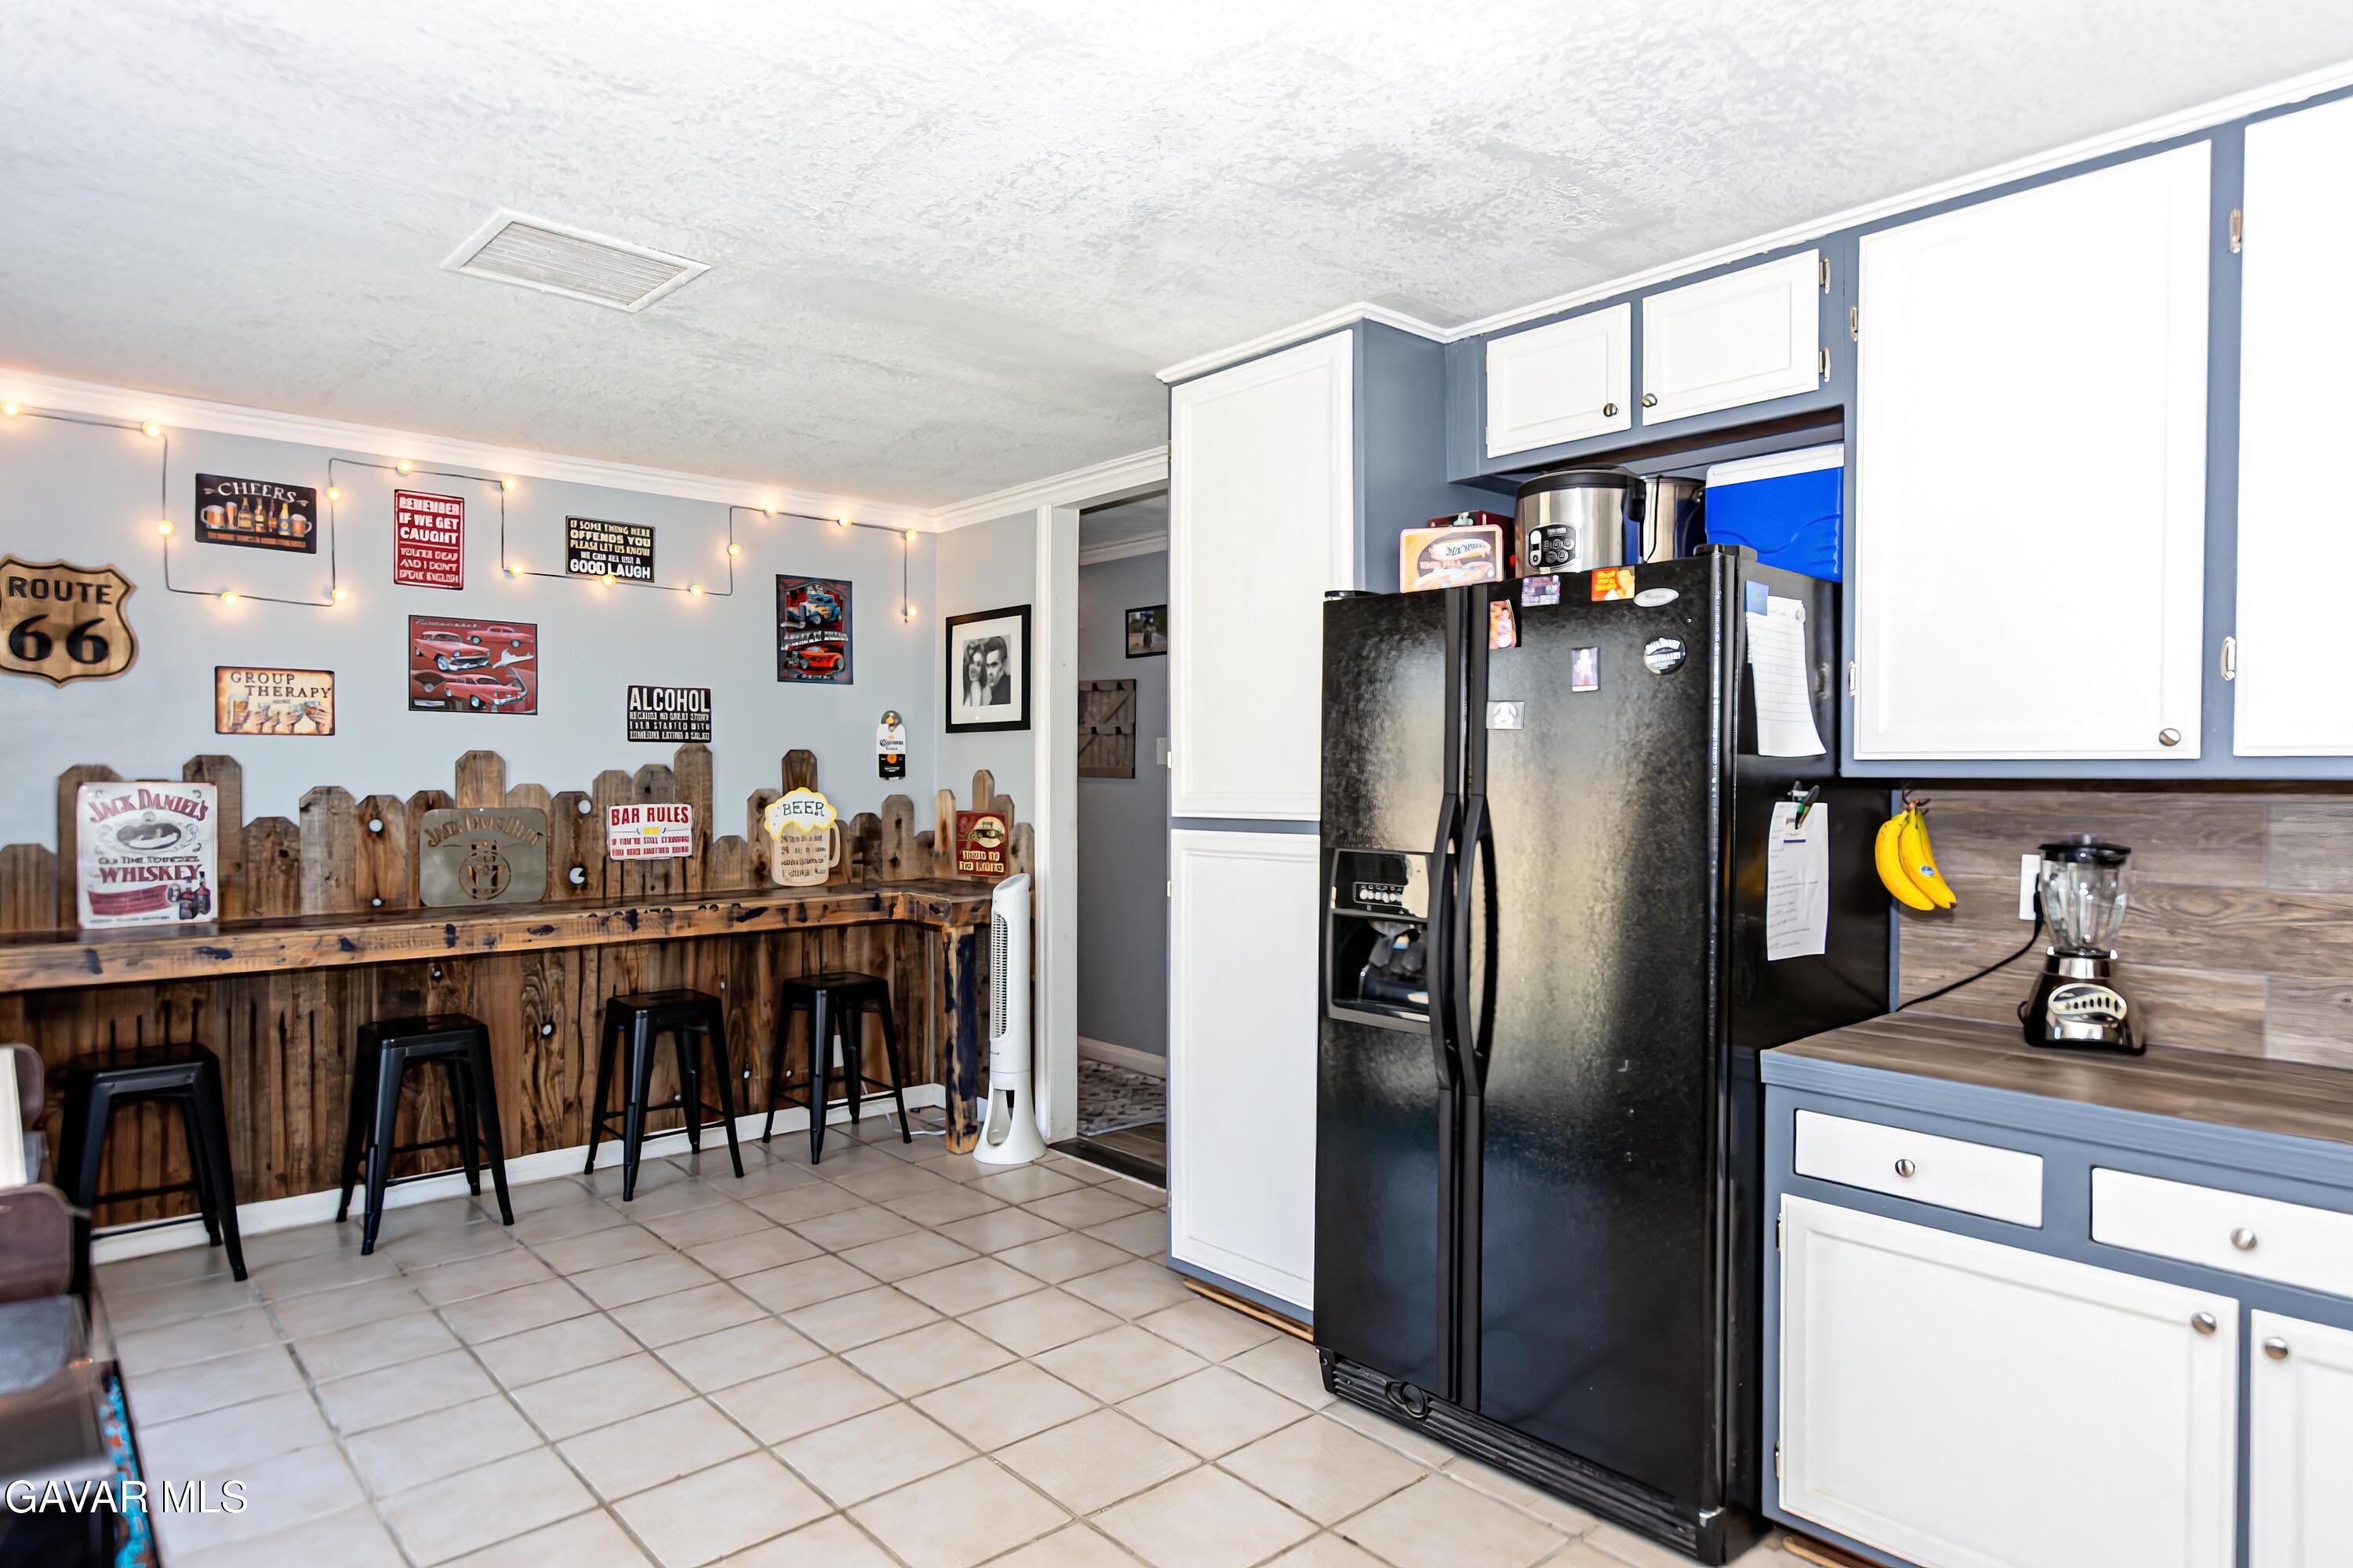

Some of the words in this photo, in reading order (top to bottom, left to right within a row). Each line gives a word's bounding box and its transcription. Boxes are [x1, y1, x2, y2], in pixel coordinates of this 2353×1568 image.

[217, 482, 296, 504] CHEERS
[398, 497, 460, 515] REMEMBER
[398, 511, 412, 524] IF
[413, 514, 433, 527] WE
[435, 517, 459, 529] GET
[400, 526, 459, 544] CAUGHT
[570, 529, 624, 544] OFFENDS
[627, 537, 651, 547] YOU
[570, 558, 606, 575] GOOD
[607, 562, 651, 579] LAUGH
[8, 577, 112, 605] ROUTE
[9, 614, 109, 664] 66
[231, 672, 295, 685] GROUP
[245, 685, 331, 698] THERAPY
[629, 687, 710, 712] ALCOHOL
[88, 795, 136, 823] JACK
[611, 807, 640, 826] BAR
[646, 806, 689, 824] RULES
[783, 801, 824, 817] BEER
[99, 864, 204, 884] WHISKEY
